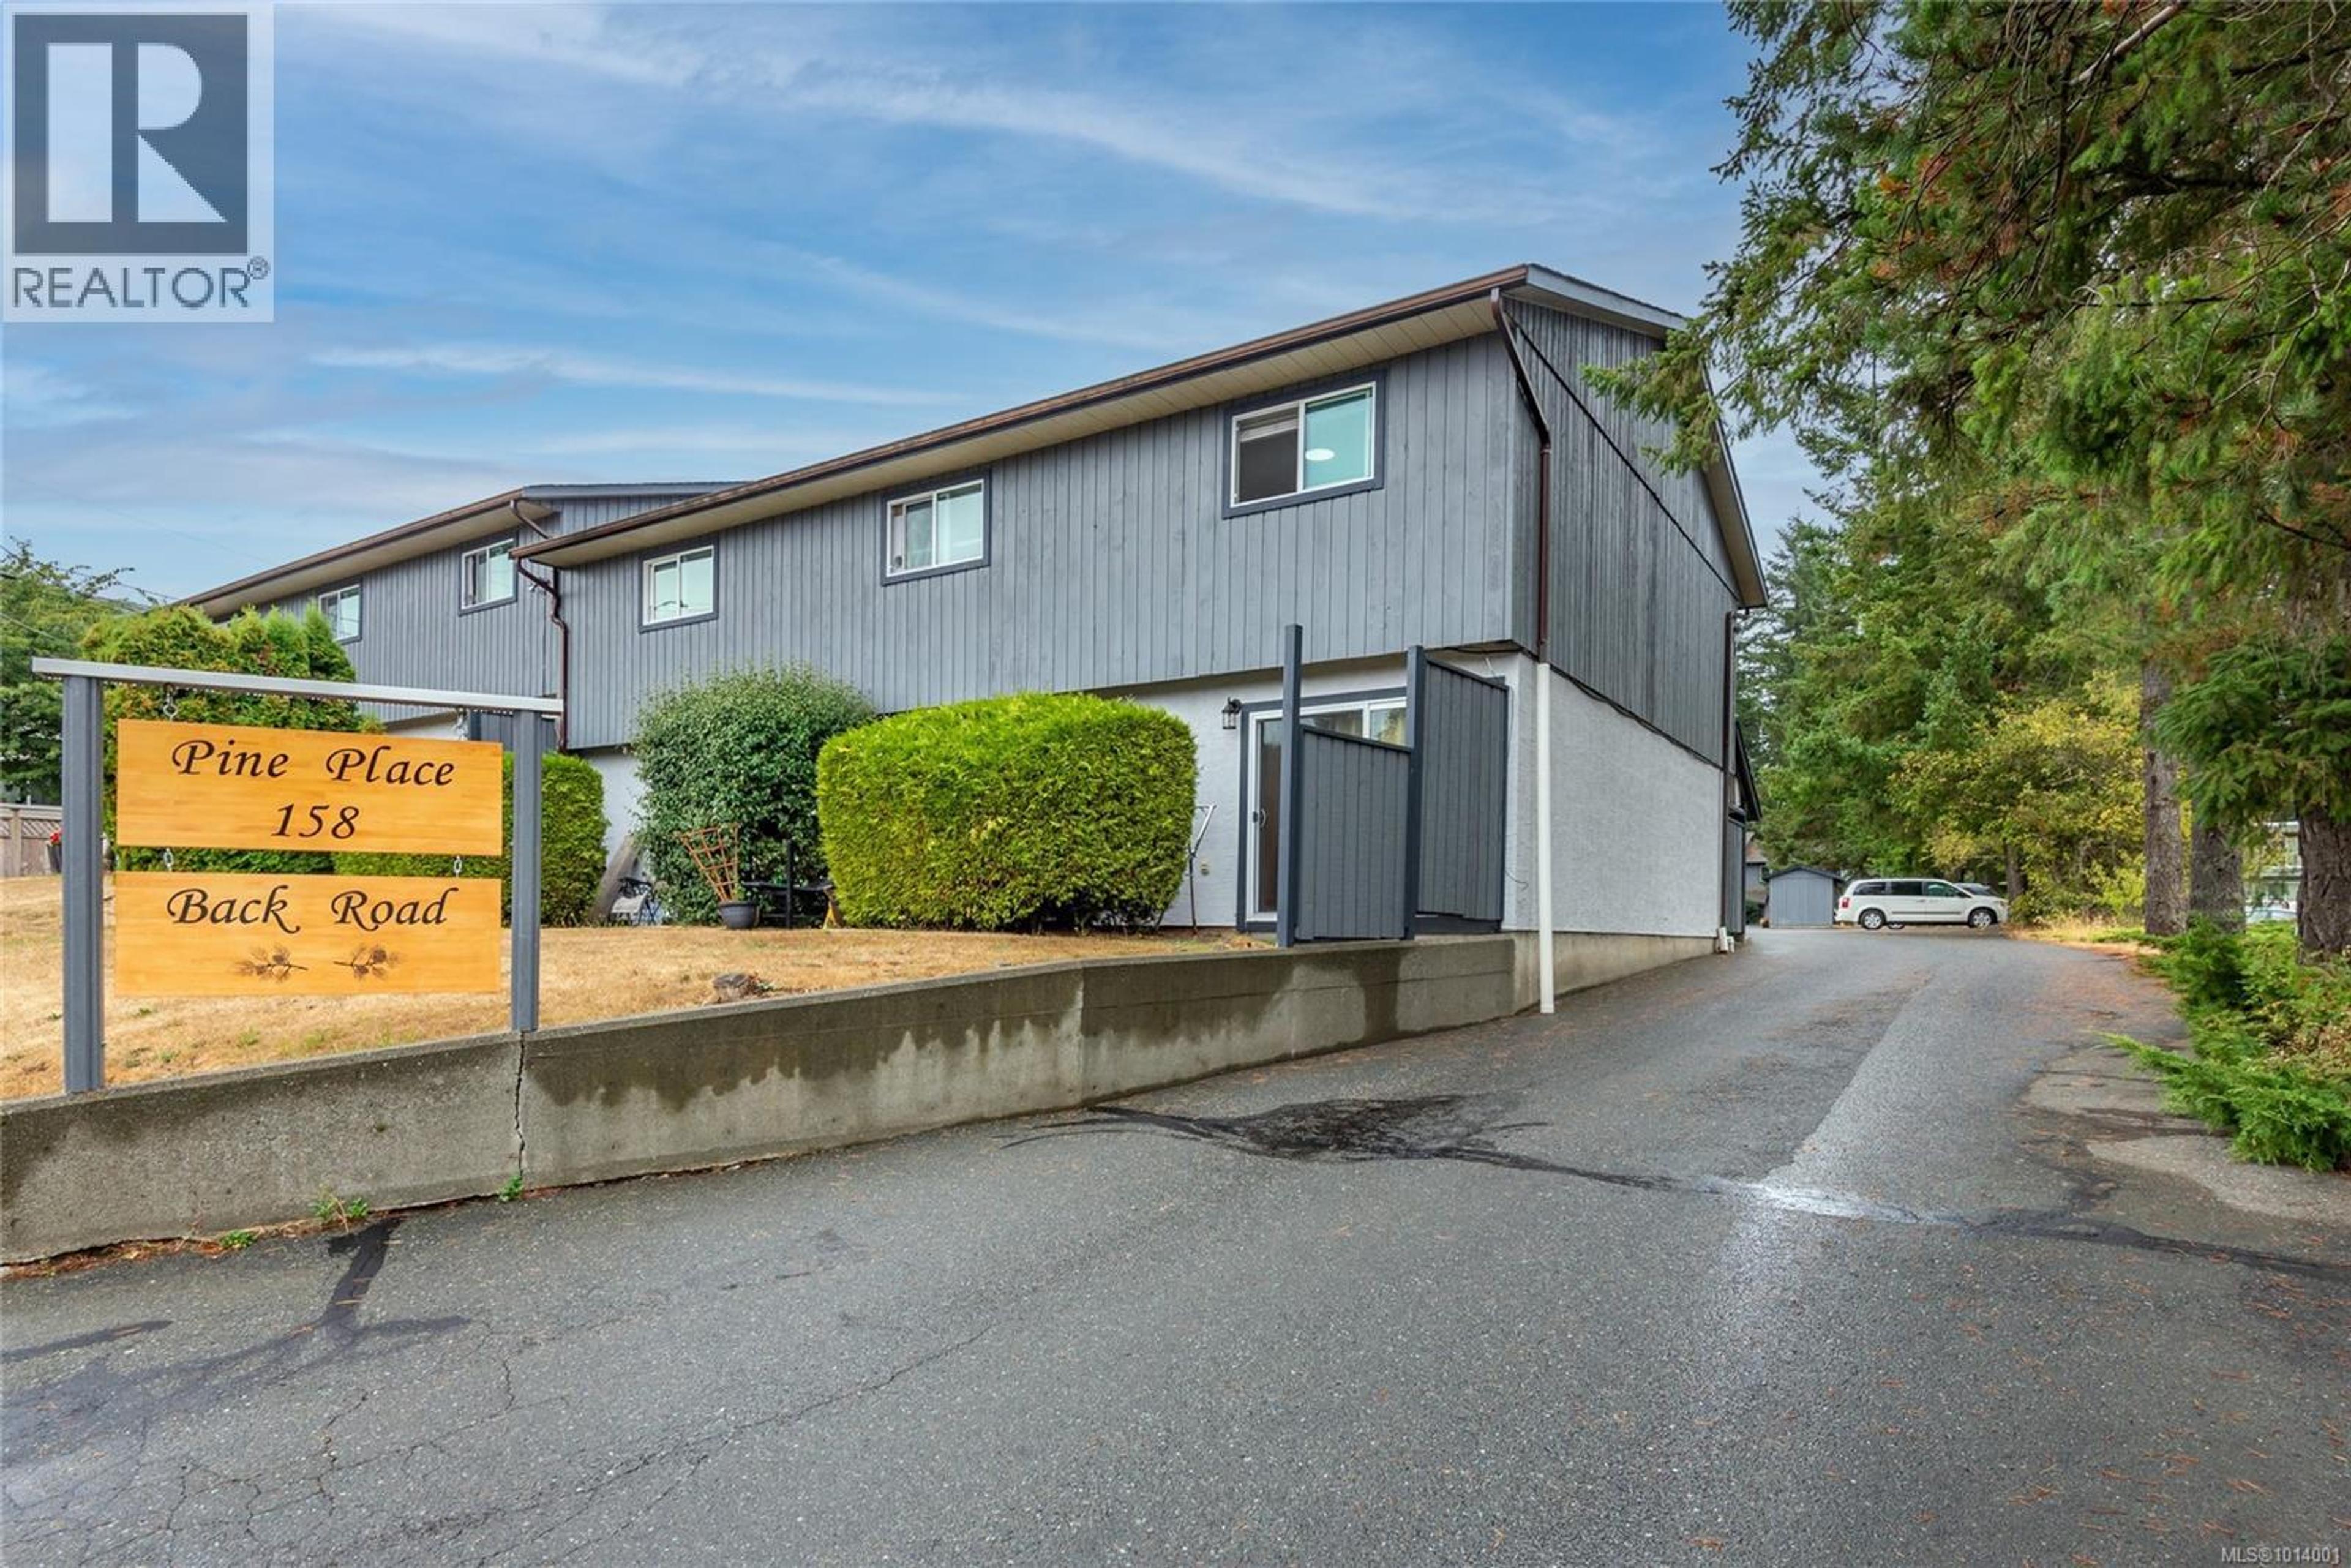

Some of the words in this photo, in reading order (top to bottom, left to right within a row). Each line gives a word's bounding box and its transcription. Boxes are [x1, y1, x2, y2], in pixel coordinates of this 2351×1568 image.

[171, 739, 290, 778] Pine
[326, 746, 455, 786] Place
[271, 803, 360, 839] 158
[167, 885, 301, 934] Back
[331, 887, 459, 931] Road
